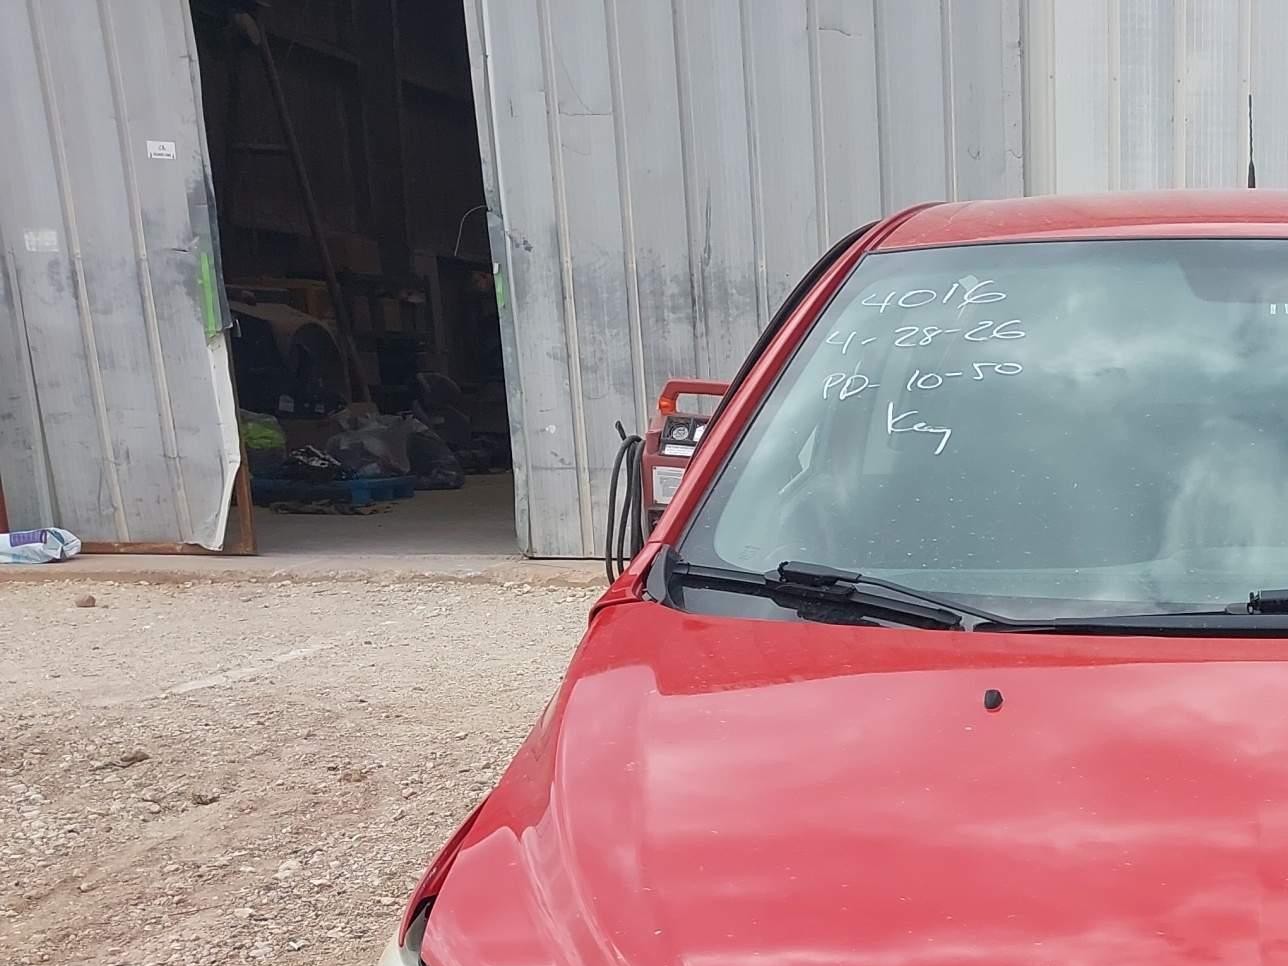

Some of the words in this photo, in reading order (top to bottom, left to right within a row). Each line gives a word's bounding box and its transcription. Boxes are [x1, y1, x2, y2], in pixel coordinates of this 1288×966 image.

[861, 280, 1007, 313] 4016
[906, 362, 1023, 392] 10-50
[887, 401, 952, 456] Key
